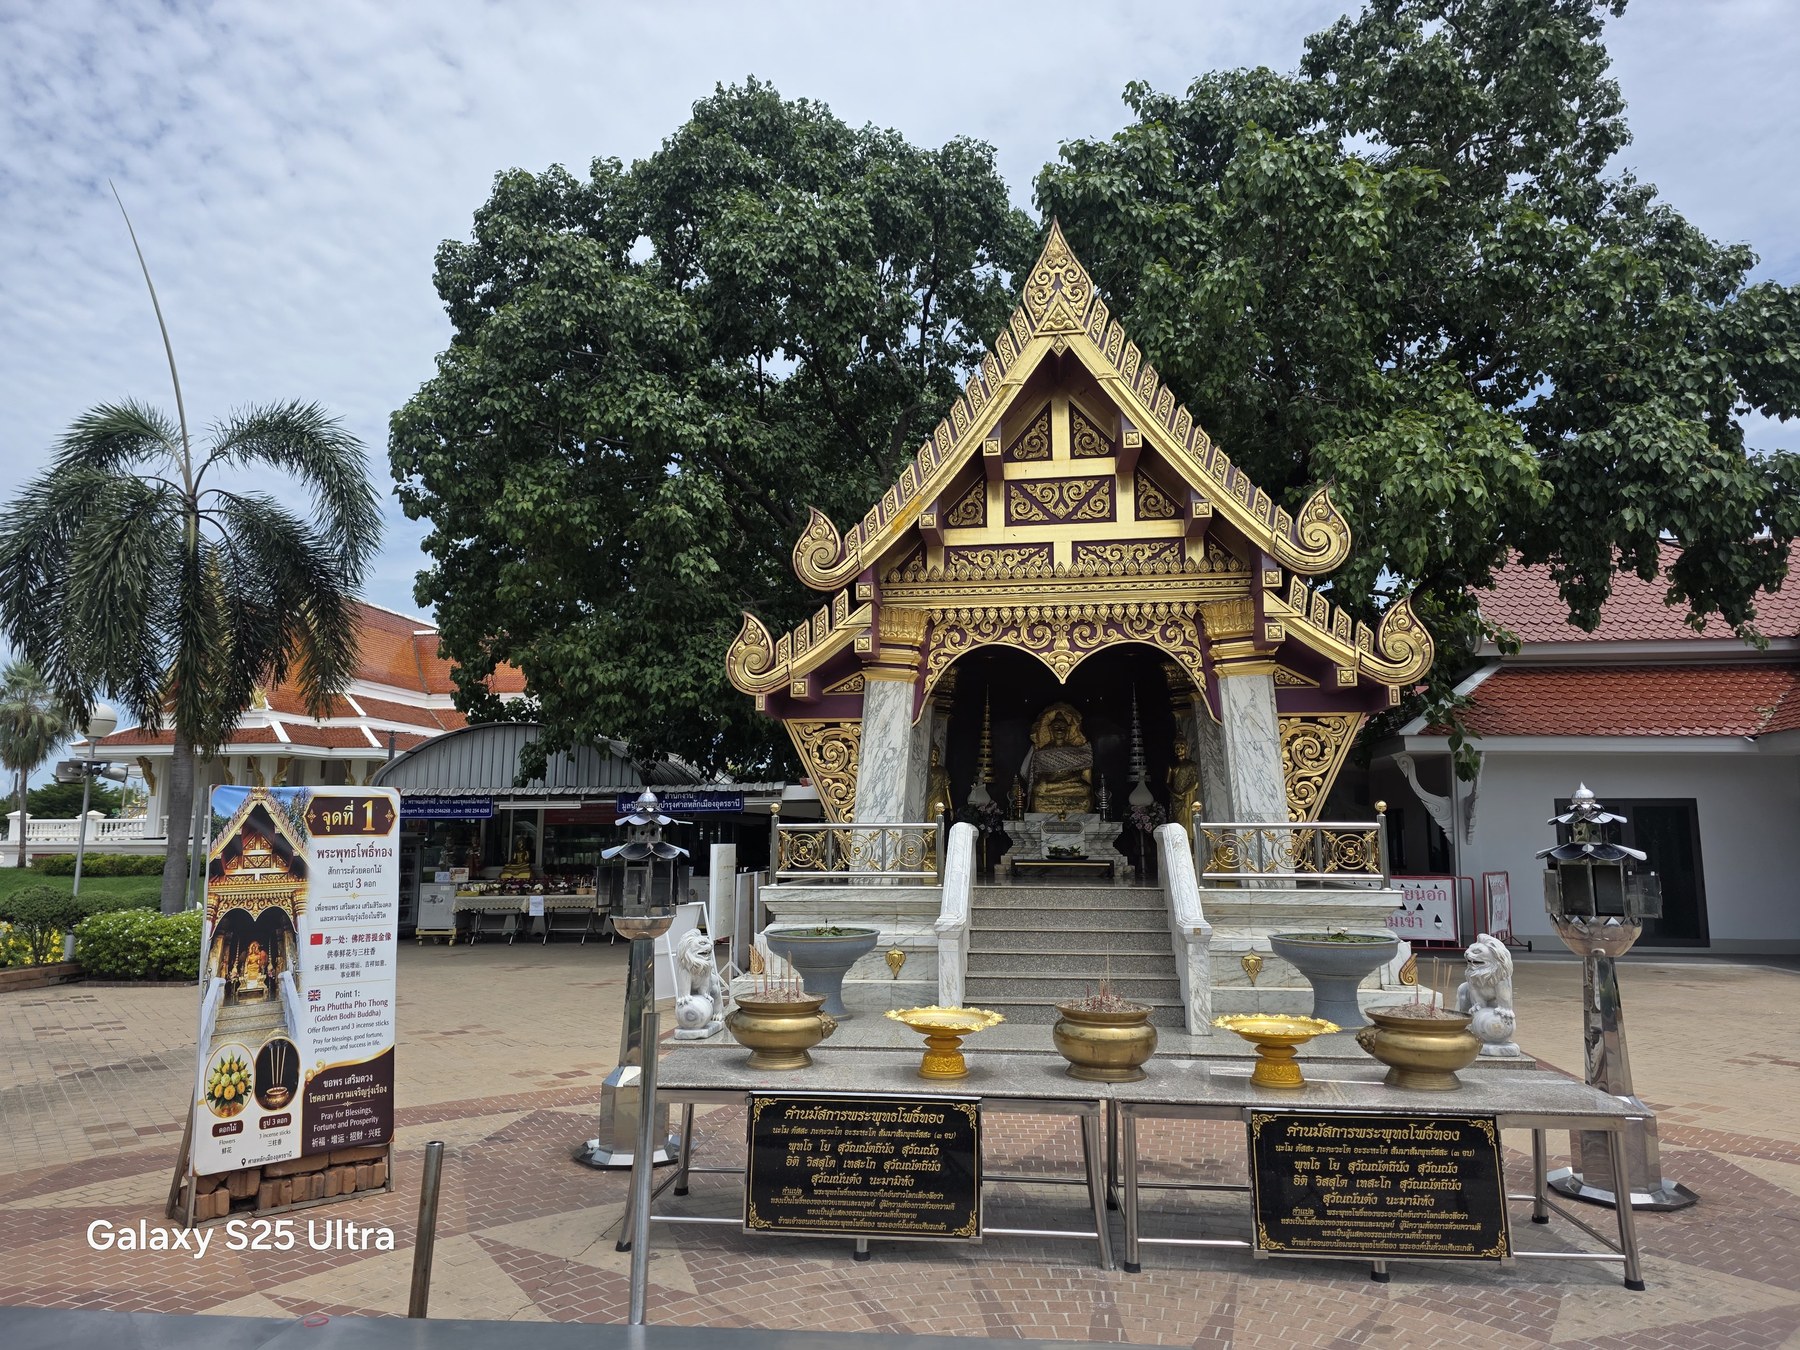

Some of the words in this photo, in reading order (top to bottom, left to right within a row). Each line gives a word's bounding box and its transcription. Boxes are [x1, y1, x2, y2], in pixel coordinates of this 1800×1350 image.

[322, 800, 354, 832] จุดที่
[362, 800, 375, 831] 1
[317, 841, 392, 863] พระพุทธโพธิ์ทอง
[328, 865, 382, 875] สักการะด้วยดอกไม้
[333, 881, 353, 891] และธูป
[355, 878, 361, 888] 3
[1404, 888, 1446, 901] ยนอก
[315, 903, 338, 911] เพื่อขอพร
[1388, 911, 1422, 928] มเข้า
[335, 990, 352, 999] Point
[355, 990, 360, 998] 1:
[310, 1004, 325, 1013] Phra
[327, 1002, 353, 1012] Phuttha
[355, 1000, 367, 1008] Pho
[369, 999, 388, 1008] Thong
[314, 1014, 338, 1024] (Golden
[339, 1012, 356, 1020] Bodhi
[357, 1010, 381, 1020] Buddha)
[307, 1026, 321, 1034] Offer
[322, 1024, 340, 1032] flowers
[356, 1021, 374, 1029] incense
[332, 1034, 353, 1043] blessings,
[354, 1033, 364, 1041] good
[365, 1031, 383, 1039] fortune,
[314, 1046, 338, 1054] prosperity,
[372, 1040, 381, 1048] life.
[323, 1078, 342, 1088] ขอพร
[345, 1073, 373, 1085] เสริมดวง
[309, 1092, 334, 1103] โชคลาภ
[336, 1084, 387, 1099] ความเจริญรุ่งเรือง
[321, 1112, 334, 1121] Pray
[336, 1110, 344, 1118] for
[346, 1108, 372, 1116] Blessings,
[784, 1105, 945, 1126] คำนมัสการพระพุทธโพธิ์ทอง
[219, 1123, 237, 1134] ดอกไม้
[314, 1123, 336, 1132] Fortune
[337, 1119, 349, 1129] and
[350, 1116, 379, 1127] Prosperity
[773, 1124, 789, 1135] นะโม
[792, 1126, 808, 1136] ตัสสะ
[312, 1136, 326, 1148] 祈福
[350, 1131, 362, 1142] 招财
[368, 1128, 382, 1138] 兴旺
[1286, 1122, 1460, 1144] คำนมัสการพระพุทธโพธิ์ทอง
[788, 1139, 813, 1152] พุทโธ
[820, 1140, 831, 1152] โย
[837, 1141, 894, 1155] สุวัณณัตถีนัง
[902, 1143, 939, 1156] สุวัณณัง
[1275, 1143, 1294, 1153] นะโม
[1295, 1144, 1314, 1154] ตัสสะ
[248, 1151, 292, 1164] ศาลหลักเมืองอุดรธานี
[786, 1156, 799, 1167] อิติ
[806, 1156, 836, 1169] วิสสุโต
[843, 1157, 876, 1169] เทสะโก
[883, 1158, 941, 1171] สุวัณณัตถีนัง
[1294, 1158, 1320, 1172] พุทโธ
[1328, 1158, 1339, 1171] โย
[1348, 1159, 1410, 1174] สุวัณณัตถีนัง
[1418, 1161, 1458, 1176] สุวัณณัง
[811, 1172, 862, 1187] สุวัณณันตัง
[869, 1174, 915, 1187] นะมามิหัง
[1293, 1176, 1308, 1187] อิติ
[1316, 1175, 1348, 1190] วิสสุโต
[1356, 1176, 1391, 1190] เทสะโก
[1400, 1178, 1462, 1192] สุวัณณัตถีนัง
[1323, 1192, 1378, 1208] สุวัณณันตัง
[1386, 1195, 1435, 1207] นะมามิหัง
